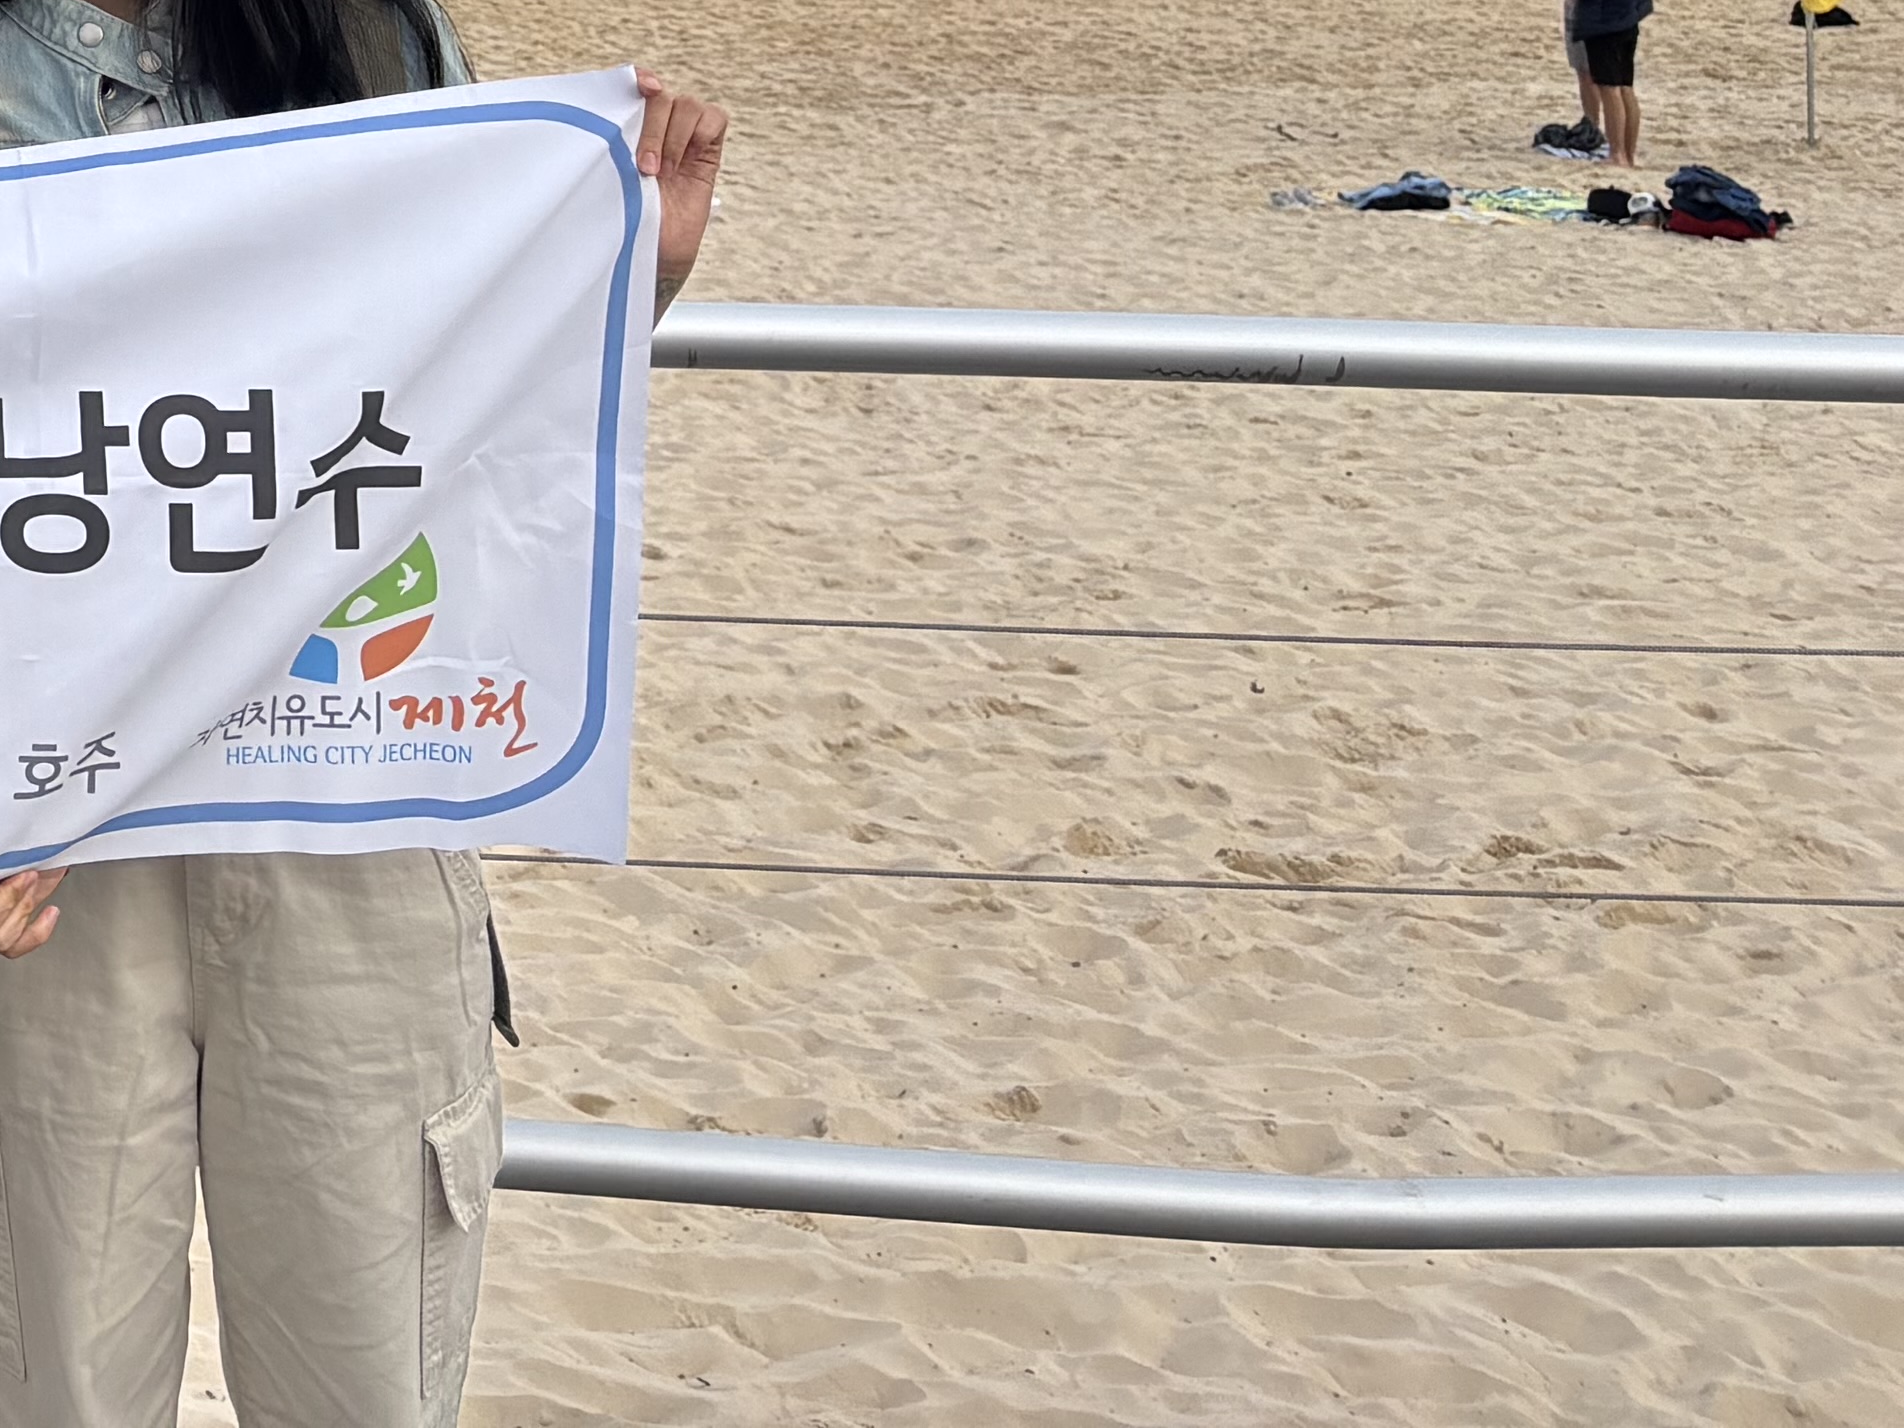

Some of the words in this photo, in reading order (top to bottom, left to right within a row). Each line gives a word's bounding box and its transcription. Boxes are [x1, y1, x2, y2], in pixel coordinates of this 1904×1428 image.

[388, 675, 539, 759] 제천
[12, 730, 123, 802] 호주
[225, 743, 318, 766] HEALING
[324, 744, 373, 765] CITY
[378, 742, 473, 765] JECHEON
